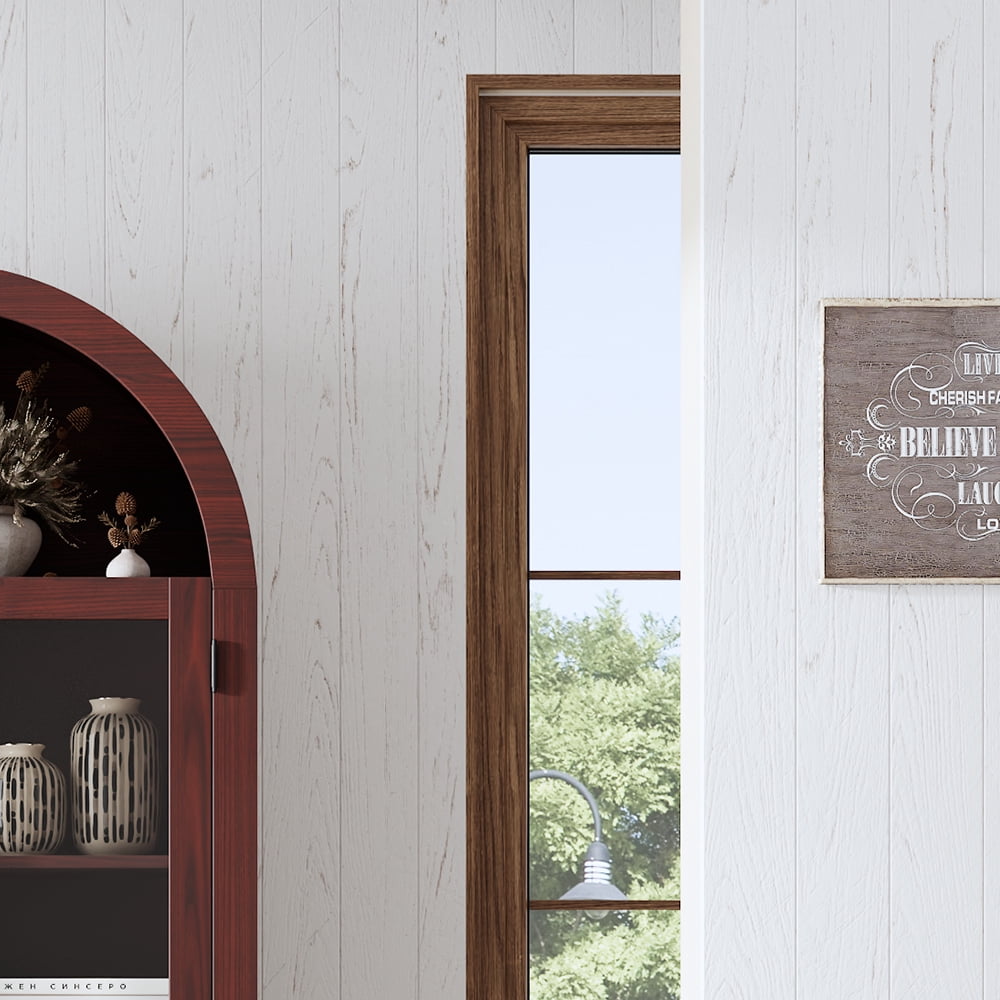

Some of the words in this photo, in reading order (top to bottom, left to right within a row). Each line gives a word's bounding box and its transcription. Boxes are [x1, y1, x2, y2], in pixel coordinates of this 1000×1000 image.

[929, 390, 986, 406] CHERISH
[900, 426, 997, 458] BELIEVE
[50, 983, 127, 991] СИНСЕРО
